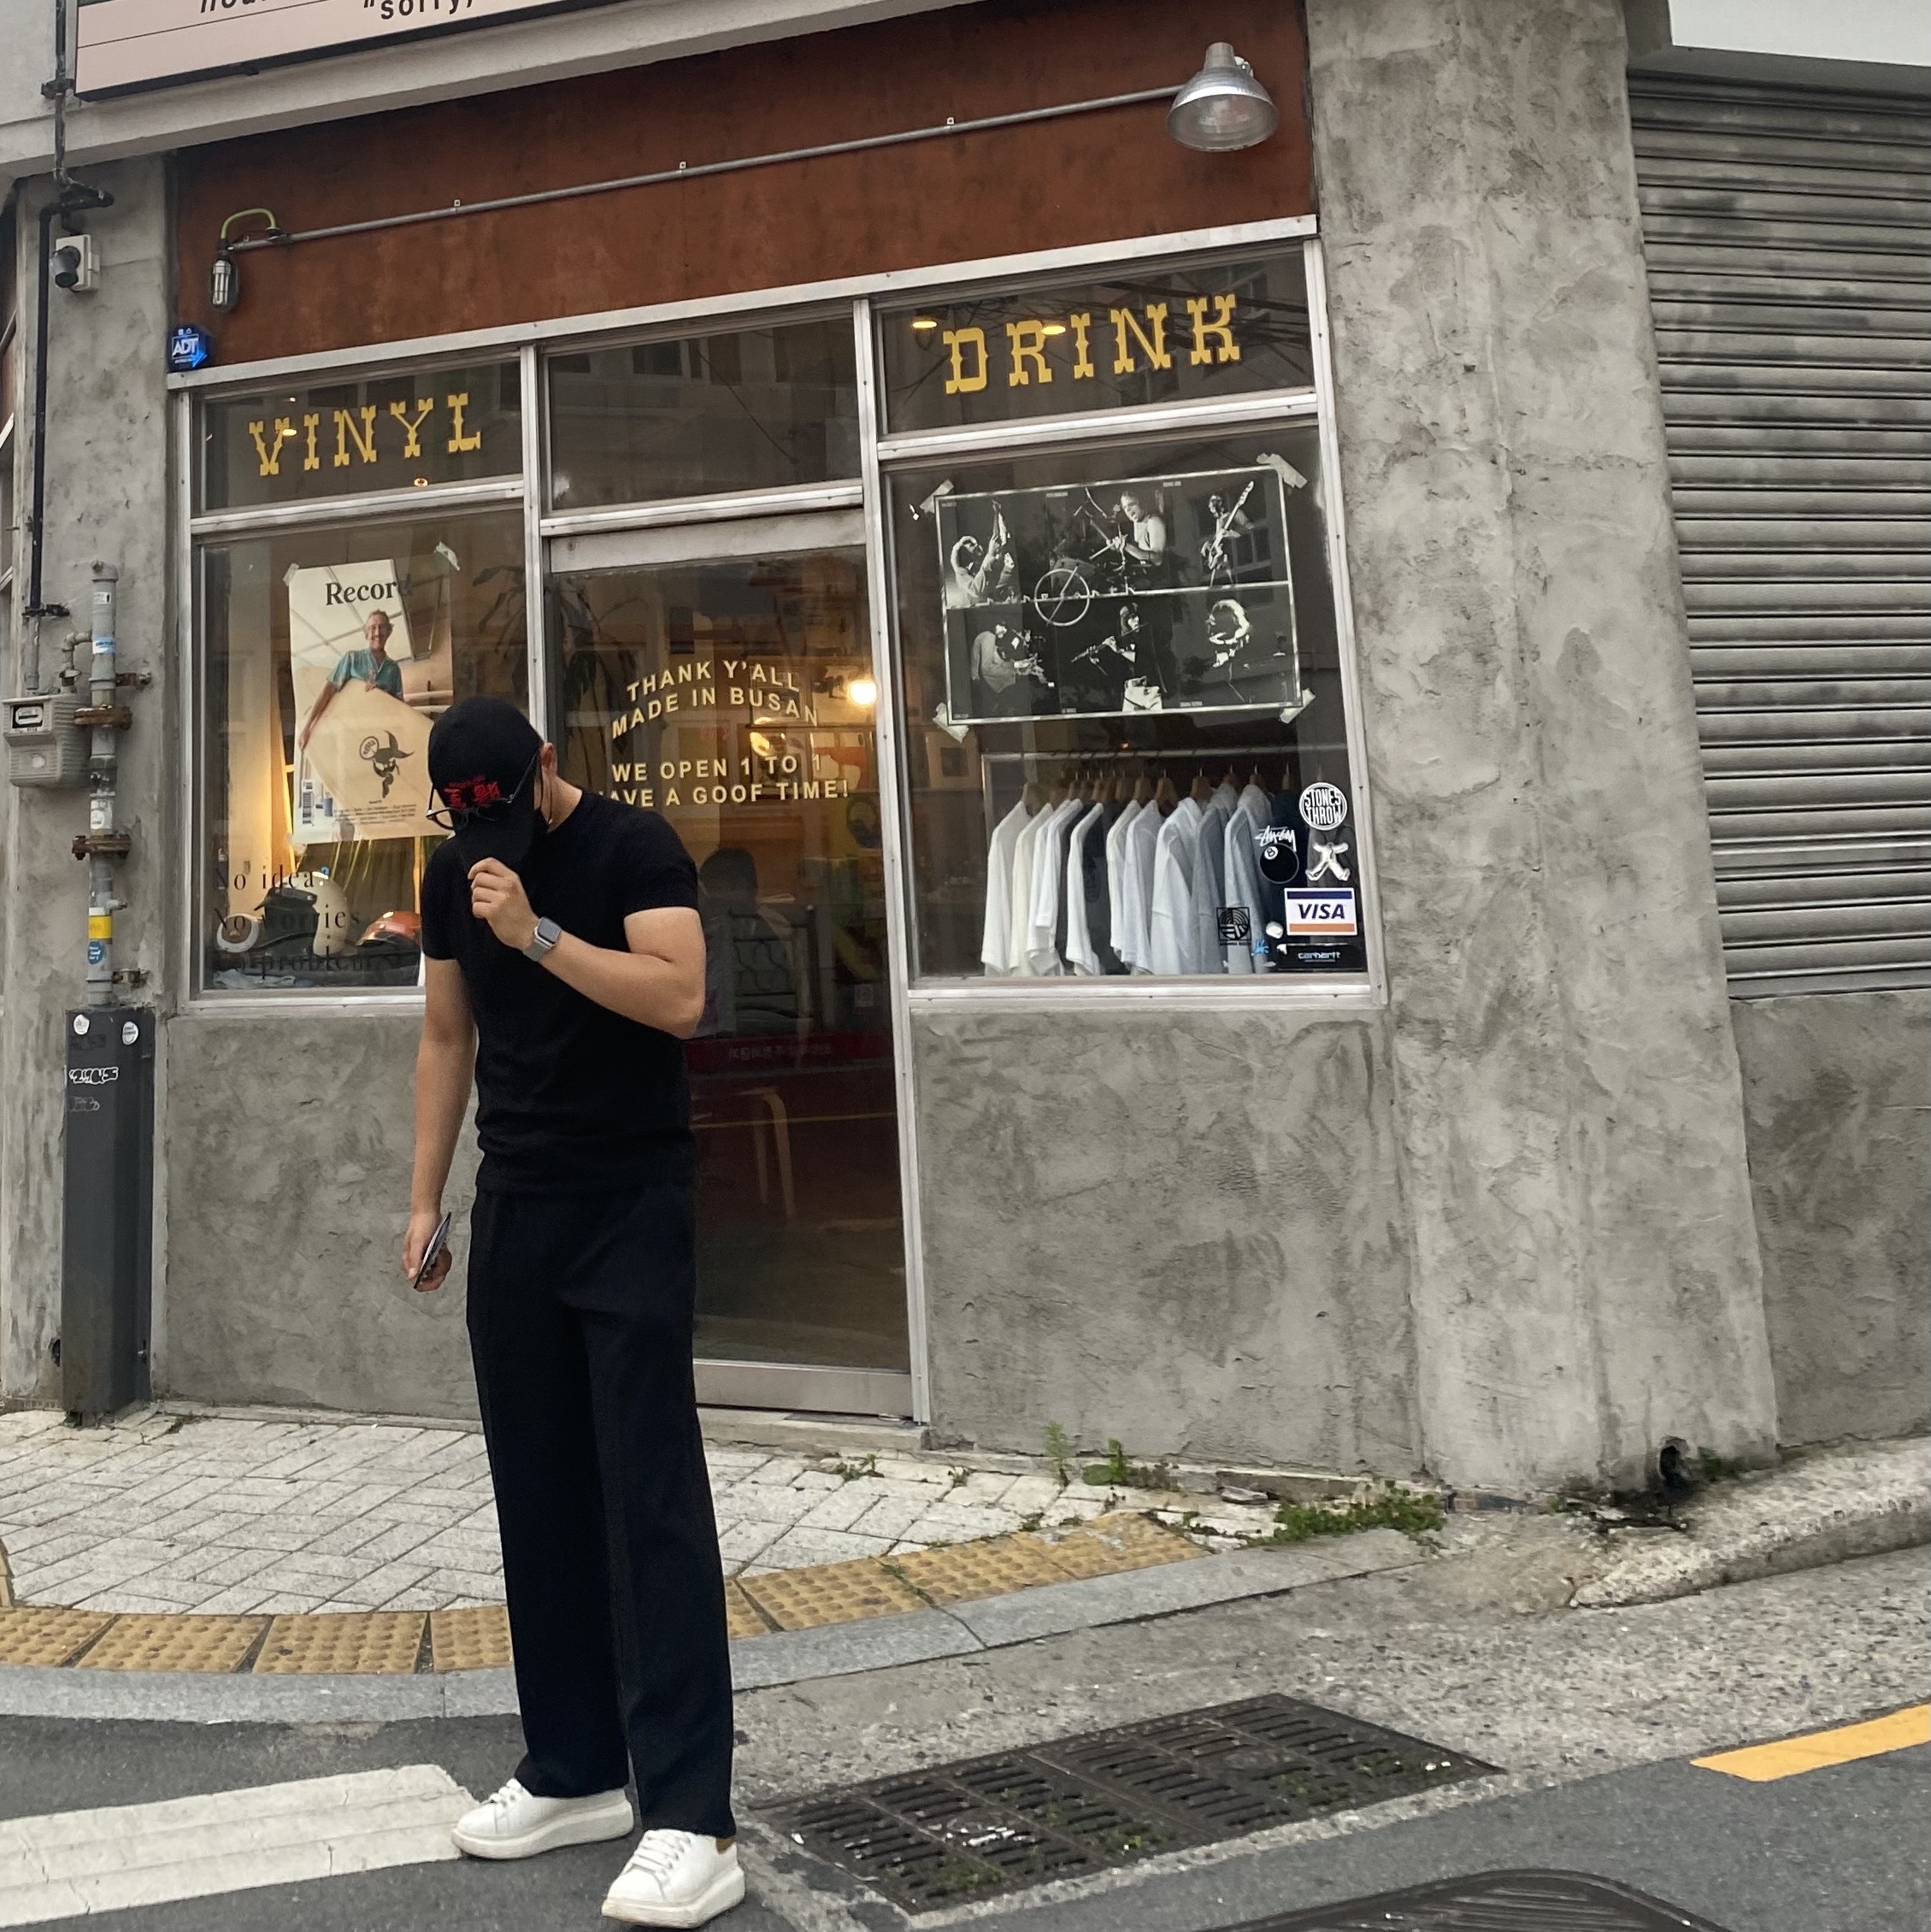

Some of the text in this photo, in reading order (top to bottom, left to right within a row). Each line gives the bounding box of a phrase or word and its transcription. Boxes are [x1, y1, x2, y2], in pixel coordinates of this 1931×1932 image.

[173, 338, 199, 356] ADT
[943, 293, 1241, 395] DRINK
[249, 392, 481, 476] VINYL
[627, 659, 800, 702] THANK Y'ALL
[611, 693, 679, 739] MADE
[692, 686, 716, 708] IN
[730, 686, 818, 727] BUSAN
[611, 753, 821, 782] WE OPEN 1 TO 1
[598, 779, 848, 807] AVE A GOOF TIME!
[1305, 787, 1341, 808] STONES
[1306, 805, 1342, 826] THROW
[1298, 904, 1346, 920] VISA
